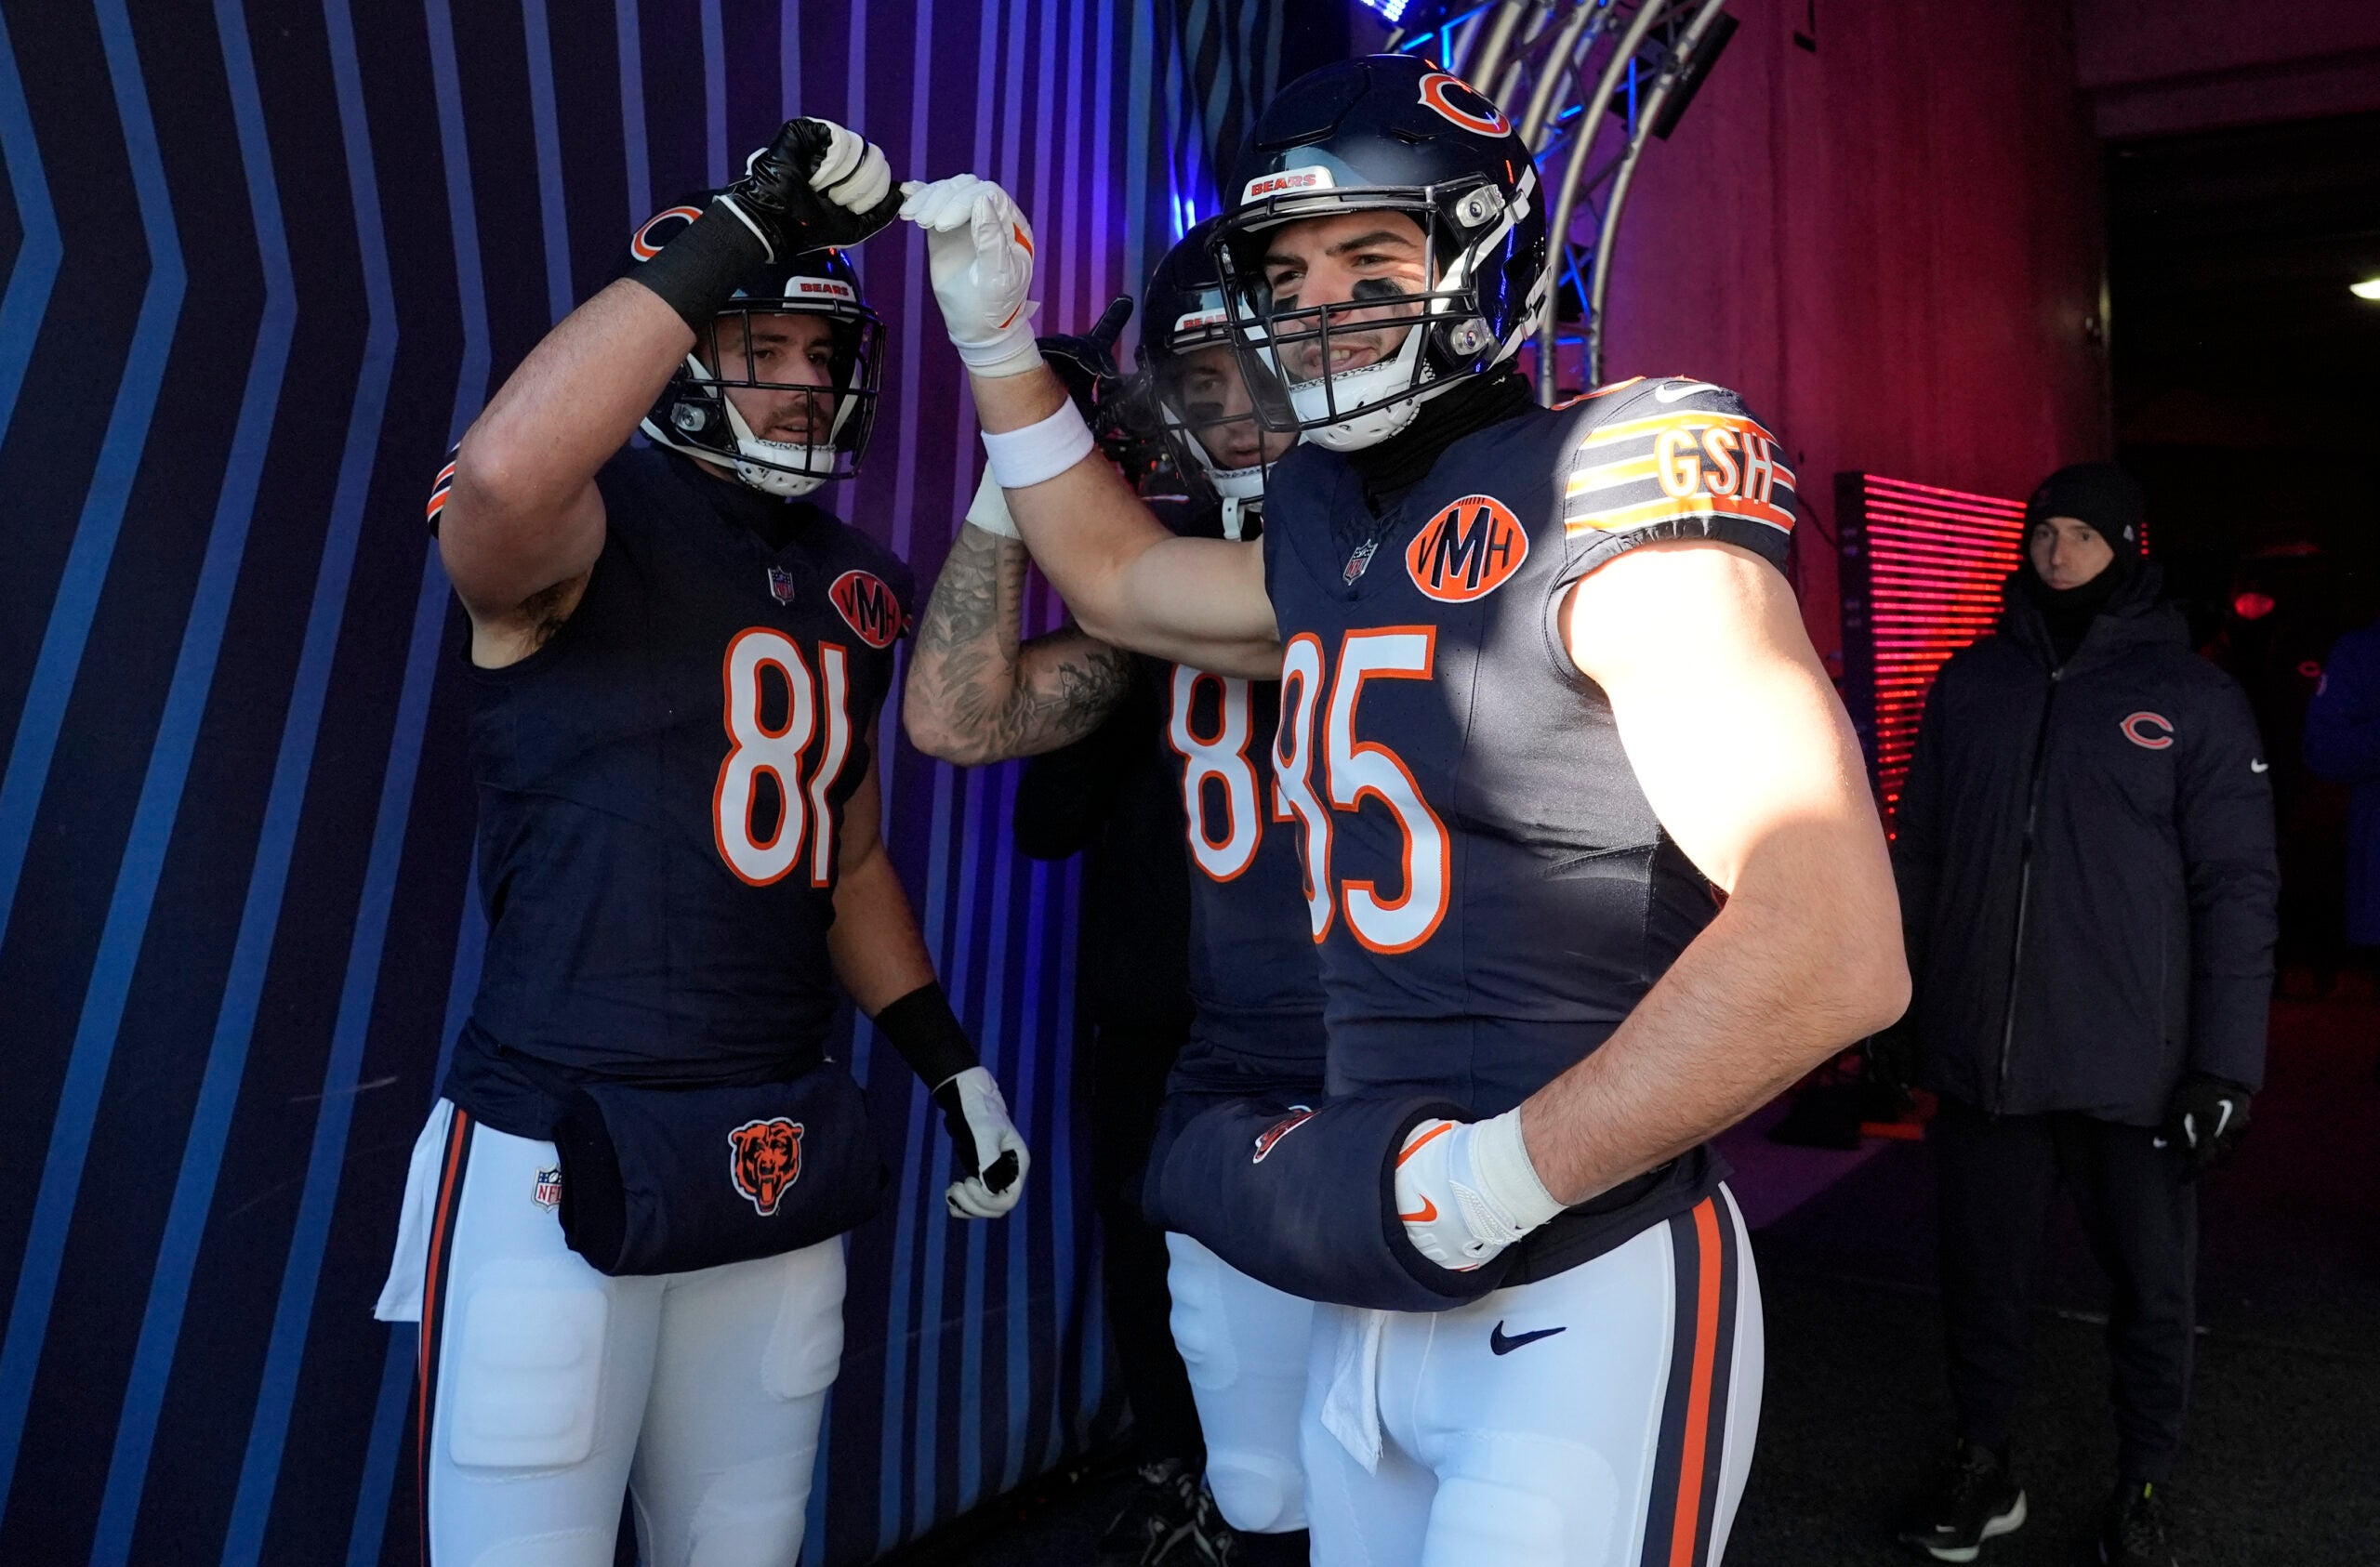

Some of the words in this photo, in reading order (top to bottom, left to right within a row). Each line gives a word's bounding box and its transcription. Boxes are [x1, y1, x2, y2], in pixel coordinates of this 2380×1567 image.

[1251, 173, 1316, 197] BEARS
[800, 283, 849, 296] BEARS
[1654, 425, 1773, 506] GSH
[1418, 505, 1514, 591] VMH
[840, 575, 896, 641] VMH
[712, 625, 853, 888] 81
[1272, 624, 1450, 955] 85
